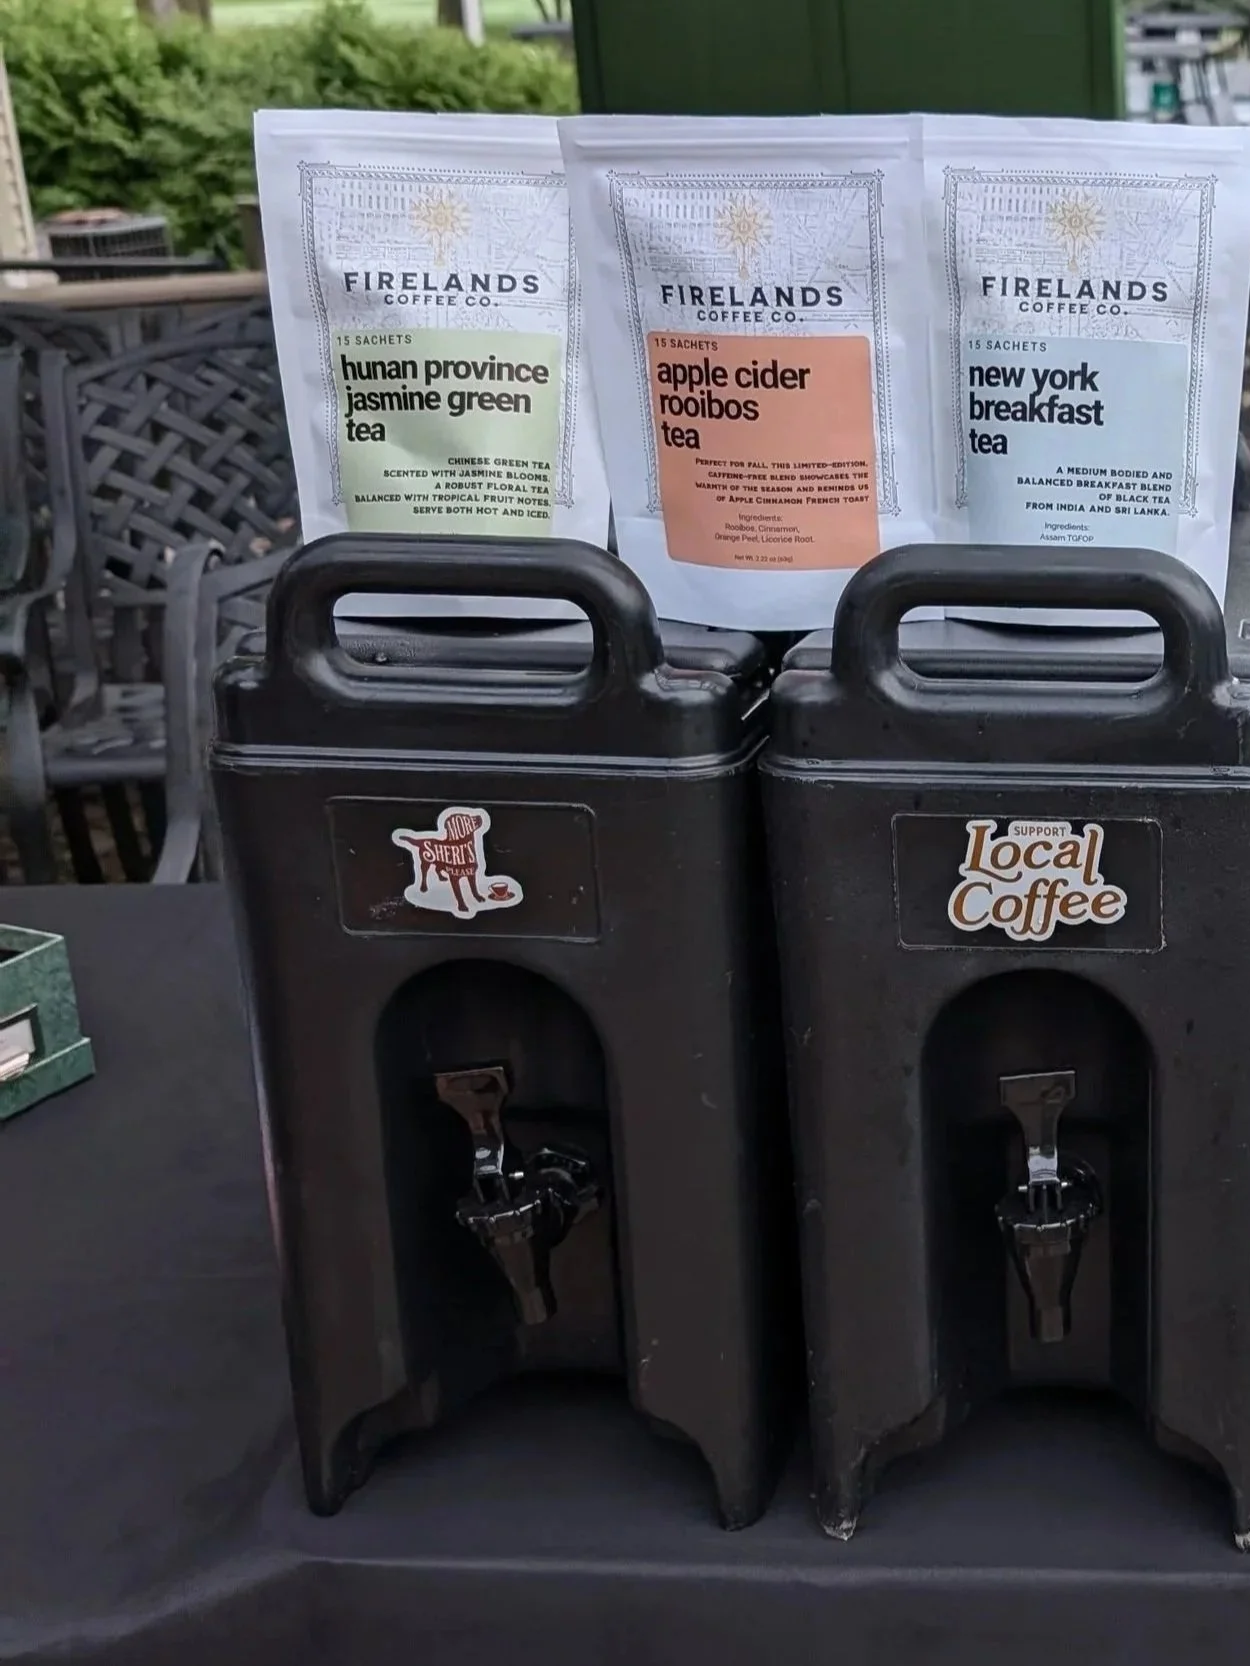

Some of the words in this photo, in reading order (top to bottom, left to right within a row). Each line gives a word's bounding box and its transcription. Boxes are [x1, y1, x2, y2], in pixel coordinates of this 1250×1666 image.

[344, 271, 540, 294] FIRELANDS
[981, 276, 1168, 302] FIRELANDS
[384, 294, 457, 306] COFFEE
[465, 295, 499, 307] CO.
[660, 284, 844, 307] FIRELANDS
[1019, 301, 1089, 315] COFFEE
[1096, 303, 1129, 315] CO.
[697, 310, 764, 323] COFFEE
[771, 311, 804, 323] CO.
[337, 336, 350, 346] 15
[355, 335, 412, 346] SACHETS
[654, 338, 667, 348] 15
[670, 338, 719, 351] SACHETS
[968, 340, 981, 350] 15
[986, 340, 1048, 352] SACHETS
[341, 354, 417, 380] hunan
[424, 355, 549, 385] province
[657, 357, 728, 392] apple
[735, 360, 811, 390] cider
[968, 364, 1025, 388] new
[1032, 362, 1100, 395] york
[345, 385, 441, 418] jasmine
[447, 390, 531, 416] green
[659, 390, 760, 421] rooibos
[968, 391, 1105, 426] breakfast
[346, 418, 386, 442] tea
[661, 421, 701, 449] tea
[969, 428, 1009, 455] tea
[448, 457, 490, 465] CHINESE
[494, 458, 529, 468] GREEN
[532, 461, 551, 470] TEA
[695, 457, 727, 467] PERFECT
[383, 469, 428, 478] SCENTED
[431, 470, 456, 478] WITH
[459, 470, 503, 479] JASMINE
[506, 472, 551, 482] BLOOMS.
[708, 471, 767, 481] CAFFEINE-FREE
[799, 473, 850, 481] SHOWCASES
[1056, 466, 1063, 474] A
[1067, 467, 1108, 477] MEDIUM
[1110, 469, 1149, 478] BODIED
[1151, 471, 1173, 480] AND
[444, 482, 483, 490] ROBUST
[486, 483, 528, 492] FLORAL
[531, 486, 550, 495] TEA
[695, 482, 728, 491] WARMTH
[1017, 477, 1074, 487] BALANCED
[1076, 479, 1138, 491] BREAKFAST
[1140, 482, 1172, 492] BLEND
[354, 494, 401, 503] BALANCED
[404, 494, 429, 502] WITH
[431, 494, 480, 503] TROPICAL
[483, 495, 514, 504] FRUIT
[1099, 493, 1113, 501] OF
[1115, 494, 1149, 503] BLACK
[1152, 495, 1171, 504] TEA
[413, 506, 443, 514] SERVE
[446, 506, 472, 515] BOTH
[476, 507, 498, 515] HOT
[502, 509, 524, 517] AND
[527, 510, 551, 519] ICED.
[1025, 502, 1054, 511] FROM
[1056, 503, 1086, 512] INDIA
[1089, 505, 1112, 513] AND
[1114, 506, 1131, 515] SRI
[1133, 507, 1170, 517] LANKA.
[1044, 521, 1090, 531] Ingredients:
[1039, 533, 1066, 542] Assam
[447, 815, 477, 841] MORE
[1014, 826, 1067, 837] SUPPORT
[423, 841, 475, 865] SHERI'S
[964, 825, 1099, 886] Local
[953, 878, 1122, 935] Coffee
